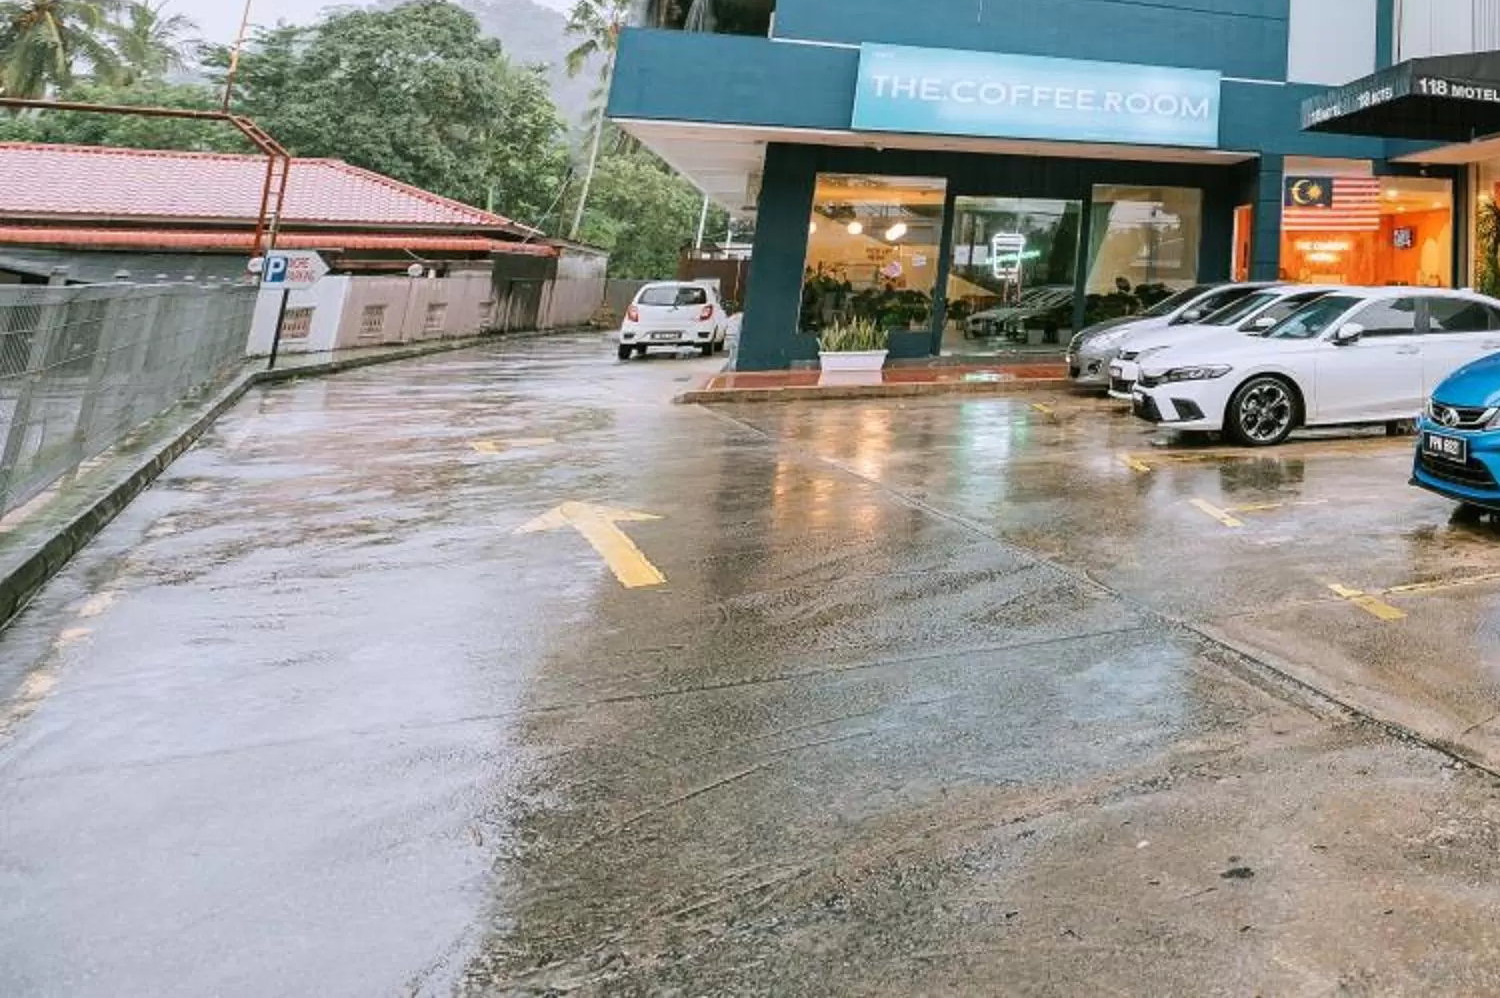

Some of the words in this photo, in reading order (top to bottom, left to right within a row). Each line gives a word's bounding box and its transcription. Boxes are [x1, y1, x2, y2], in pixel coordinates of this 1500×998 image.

[1419, 77, 1447, 95] 118
[1451, 83, 1500, 102] MOTEL
[266, 257, 285, 281] P
